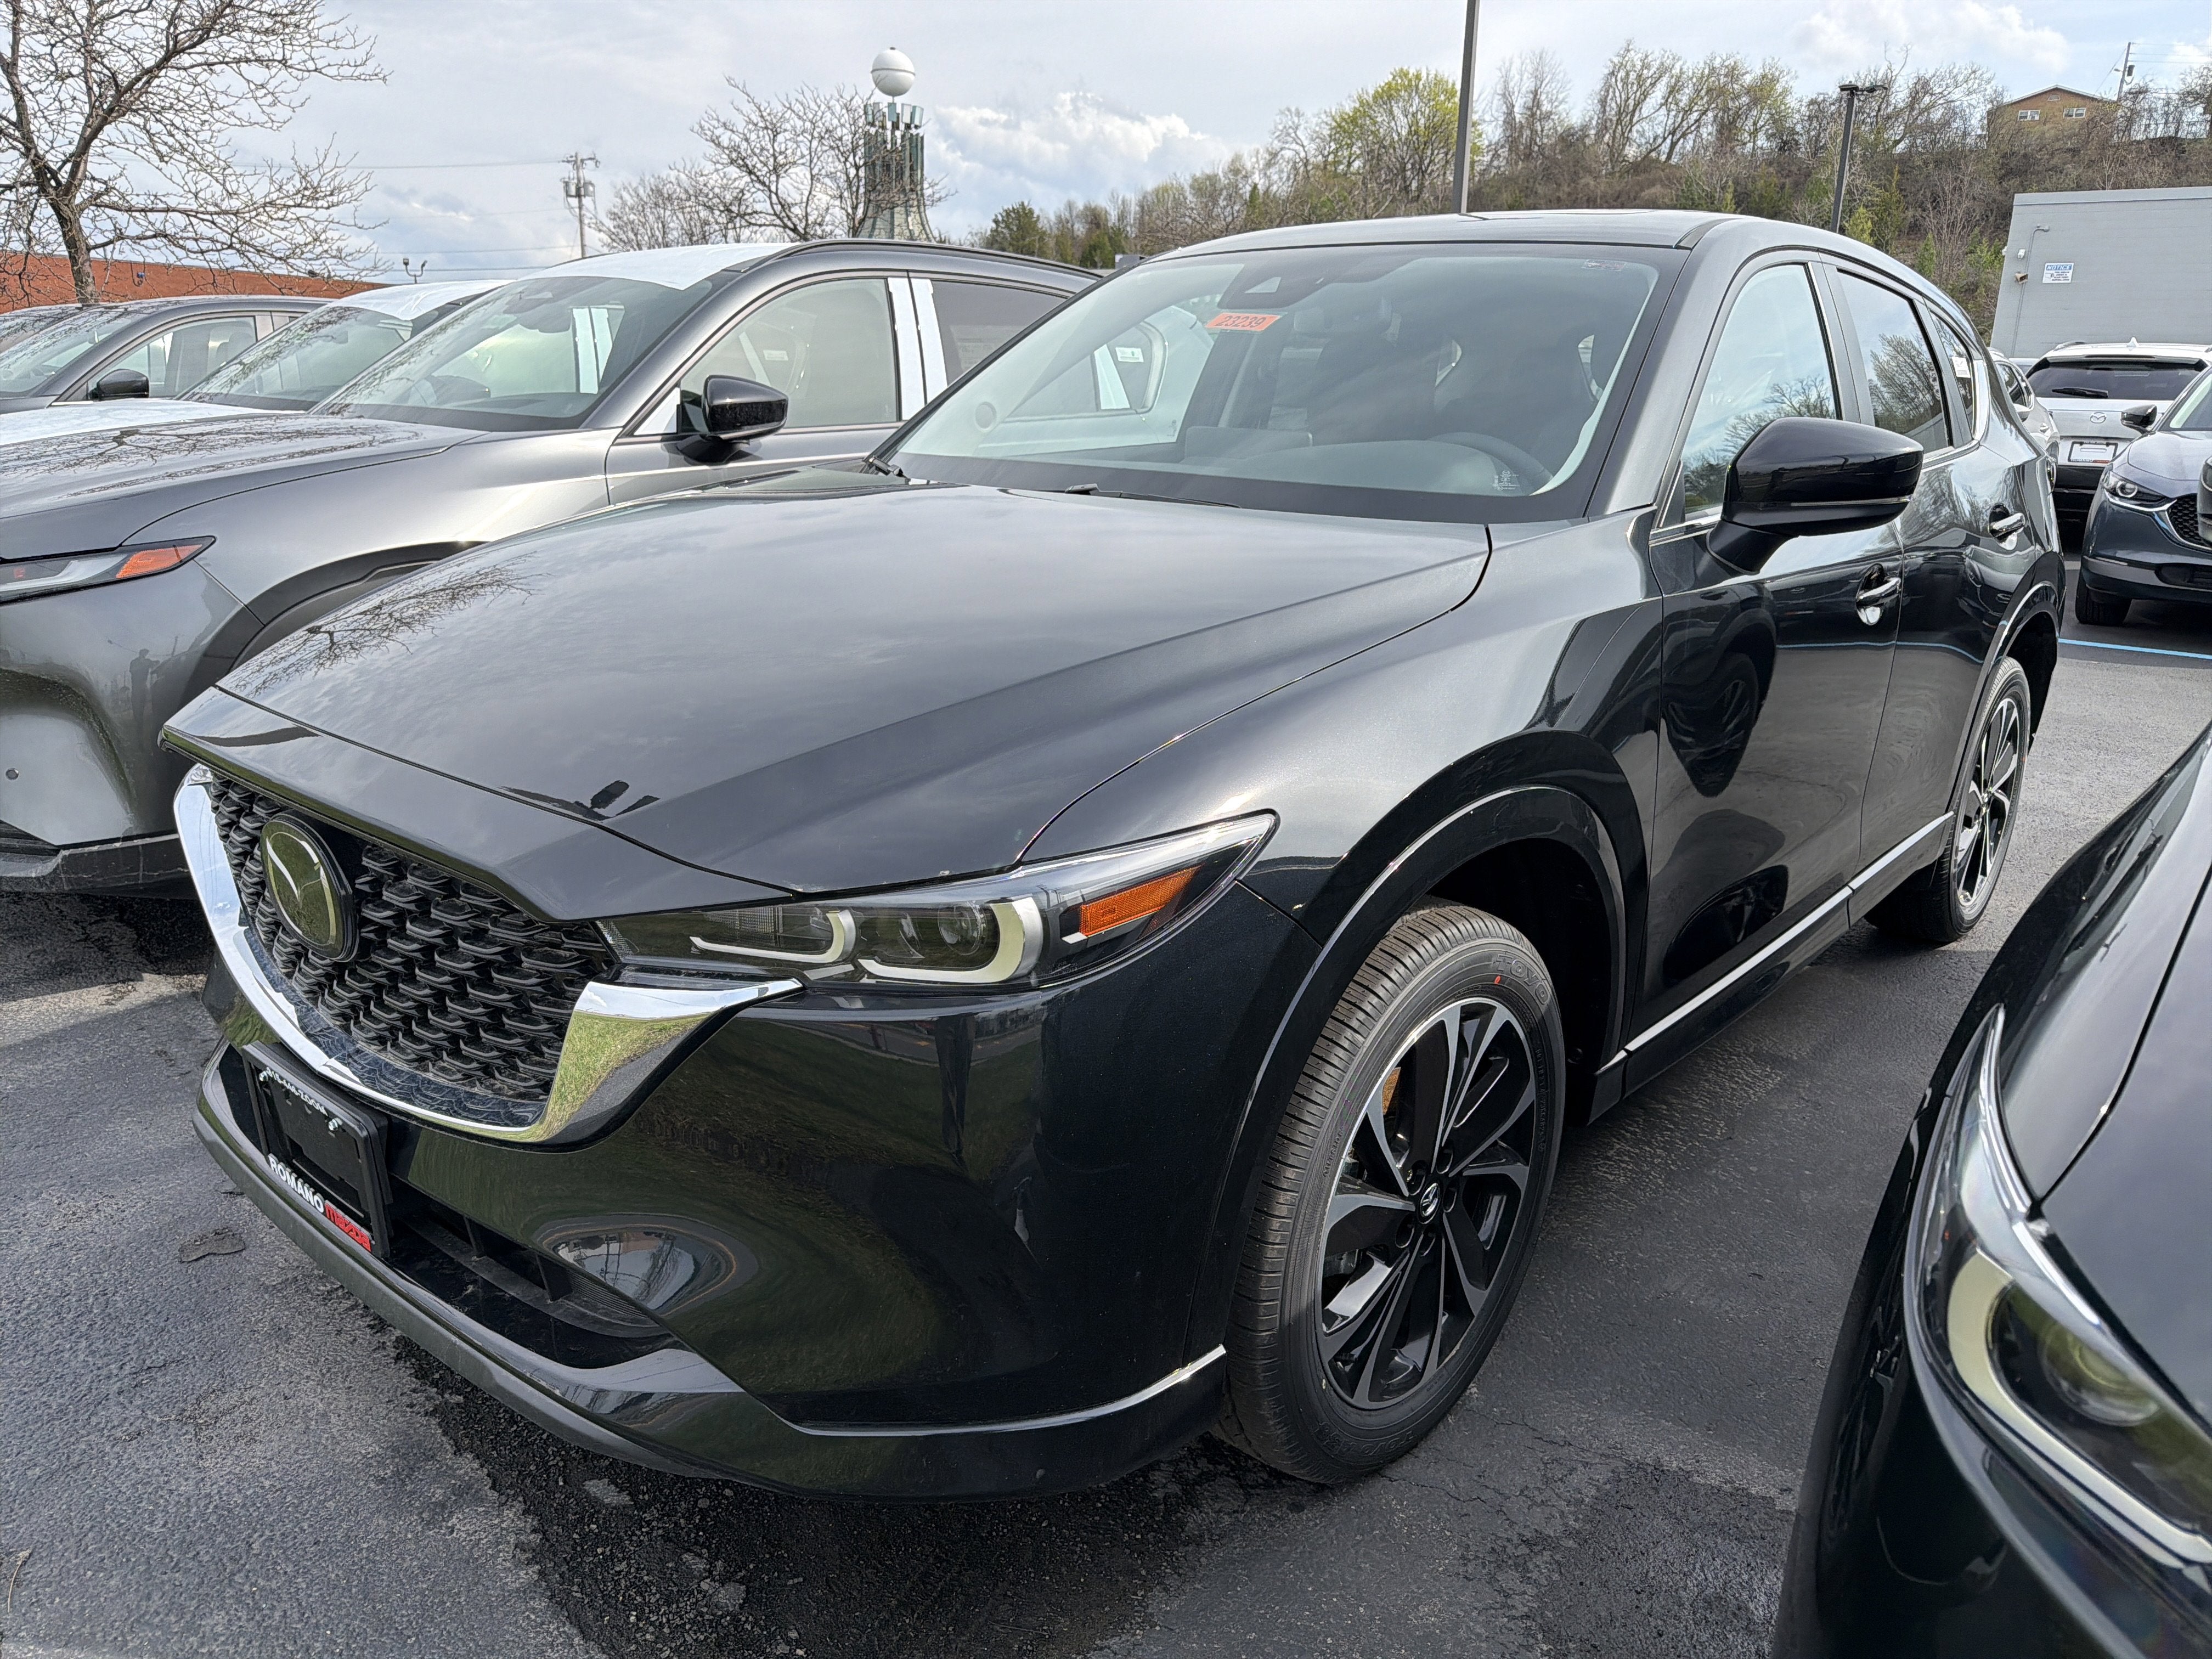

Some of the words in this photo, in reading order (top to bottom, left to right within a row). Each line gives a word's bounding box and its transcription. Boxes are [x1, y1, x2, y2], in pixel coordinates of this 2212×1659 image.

[1215, 315, 1266, 328] 23239
[1496, 953, 1548, 1006] TOYO
[268, 1154, 325, 1213] ROMANO
